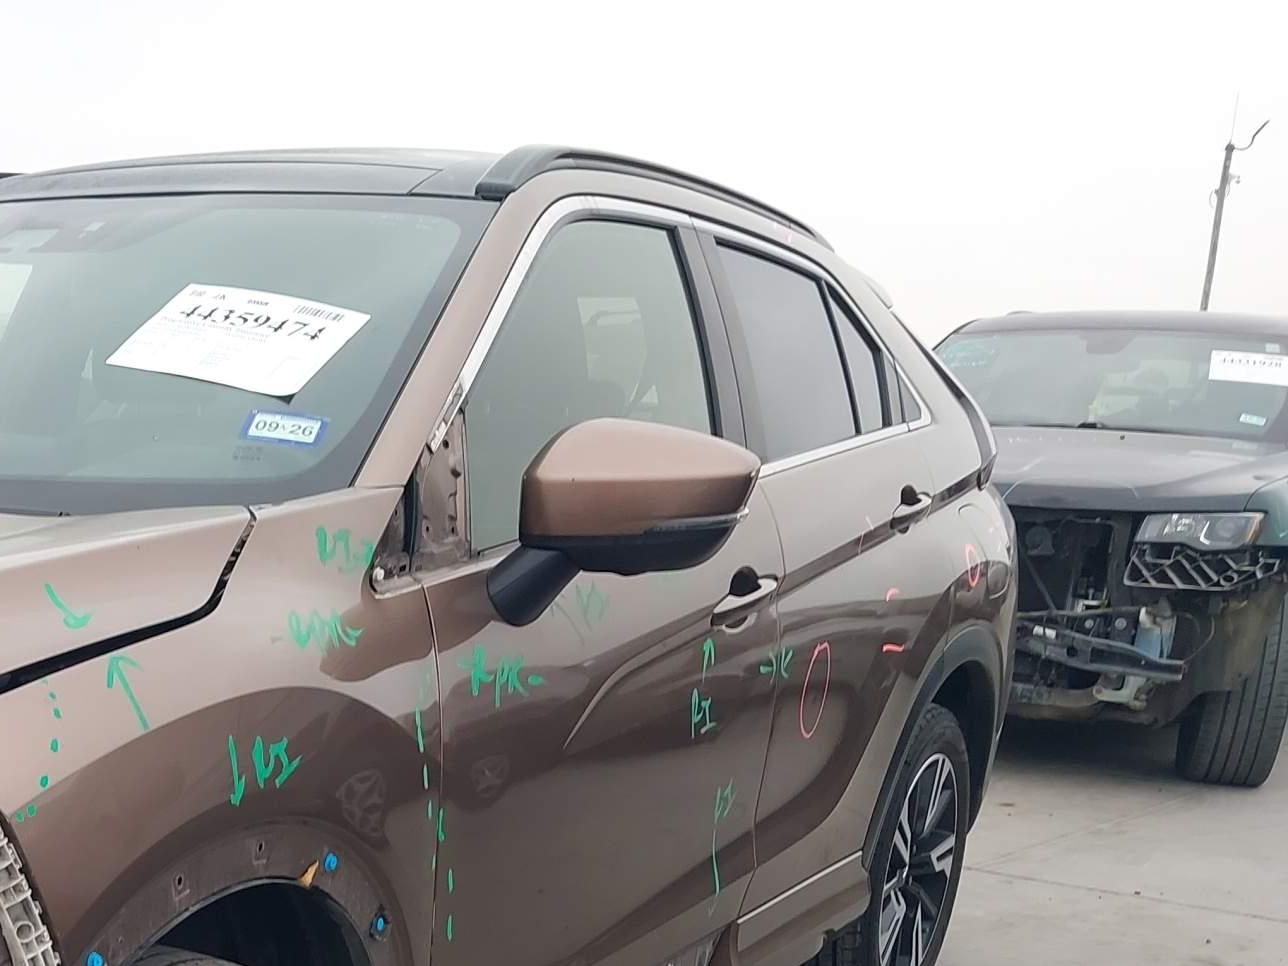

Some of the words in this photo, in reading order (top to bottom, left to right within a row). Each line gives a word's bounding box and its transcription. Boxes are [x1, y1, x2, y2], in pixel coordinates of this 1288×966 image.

[179, 304, 327, 341] 44359474
[254, 419, 280, 433] 09
[289, 423, 315, 437] 26
